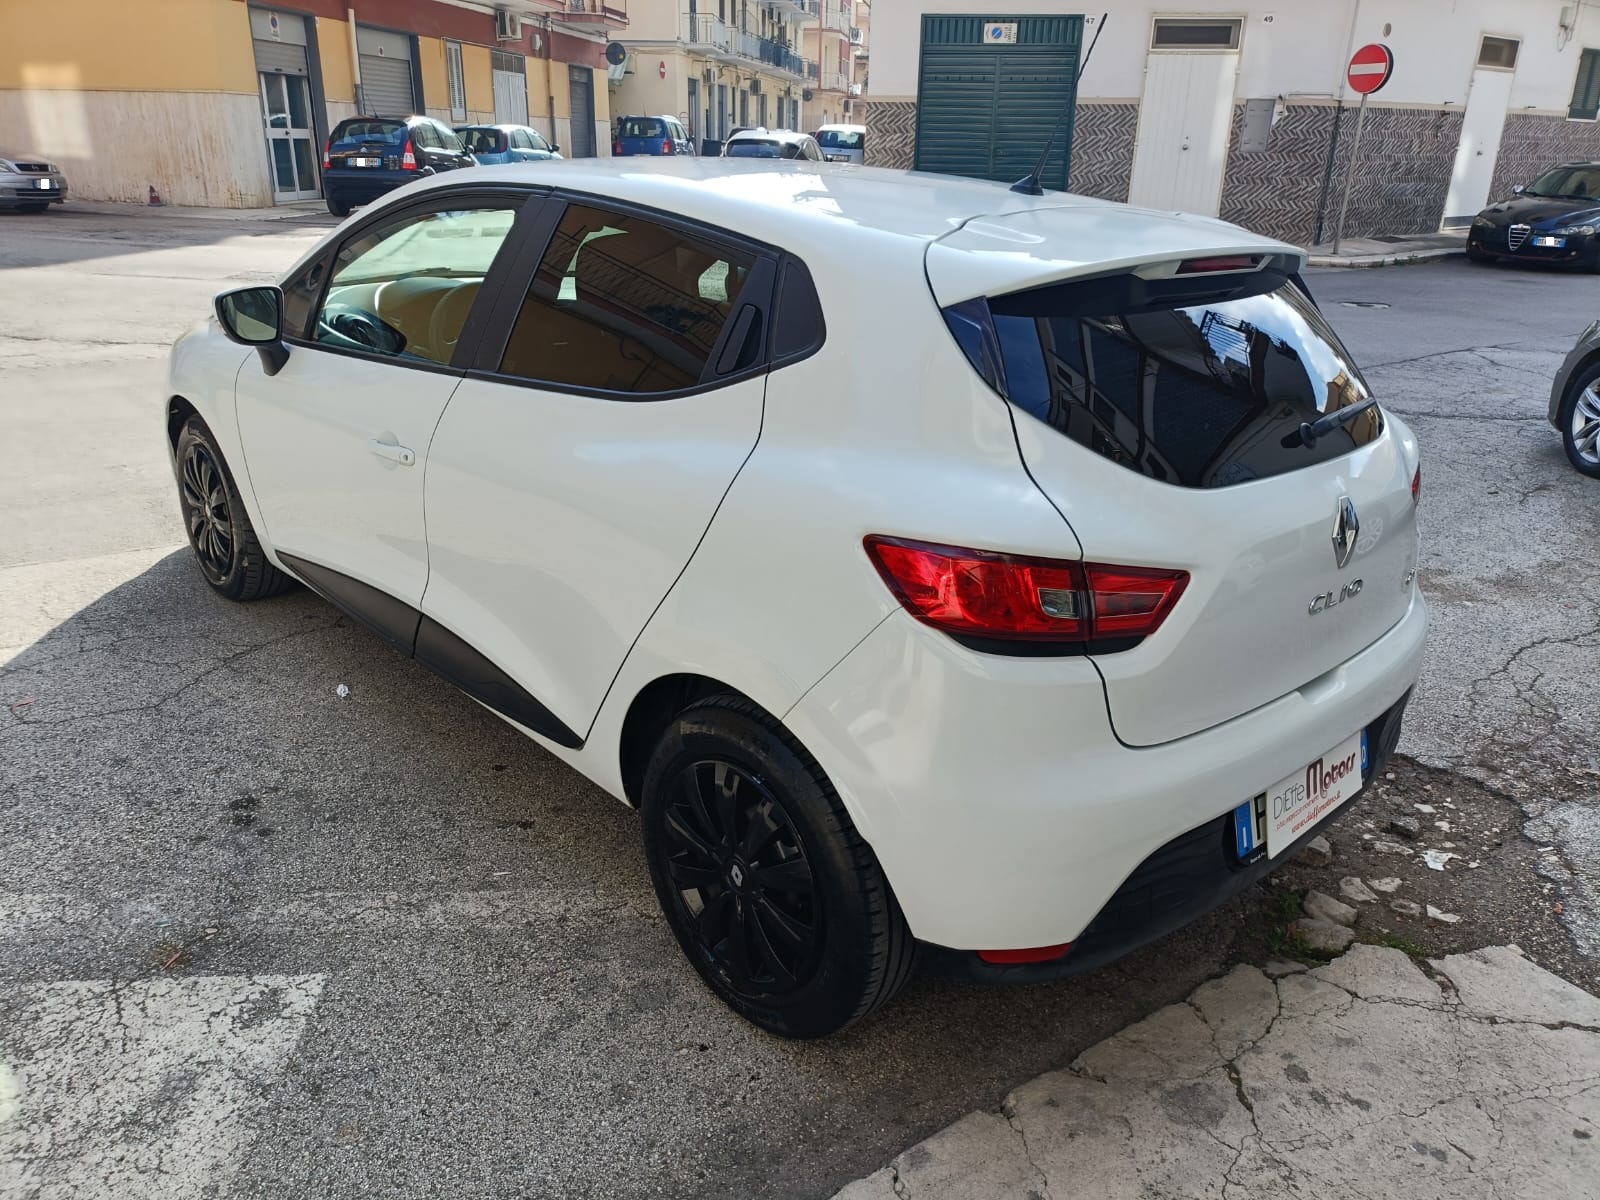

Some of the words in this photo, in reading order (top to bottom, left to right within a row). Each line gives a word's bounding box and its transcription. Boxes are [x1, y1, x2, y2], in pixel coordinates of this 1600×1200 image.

[1085, 17, 1095, 25] 47
[1263, 15, 1274, 23] 49
[1308, 577, 1364, 616] CLIO
[1306, 752, 1356, 800] Motors
